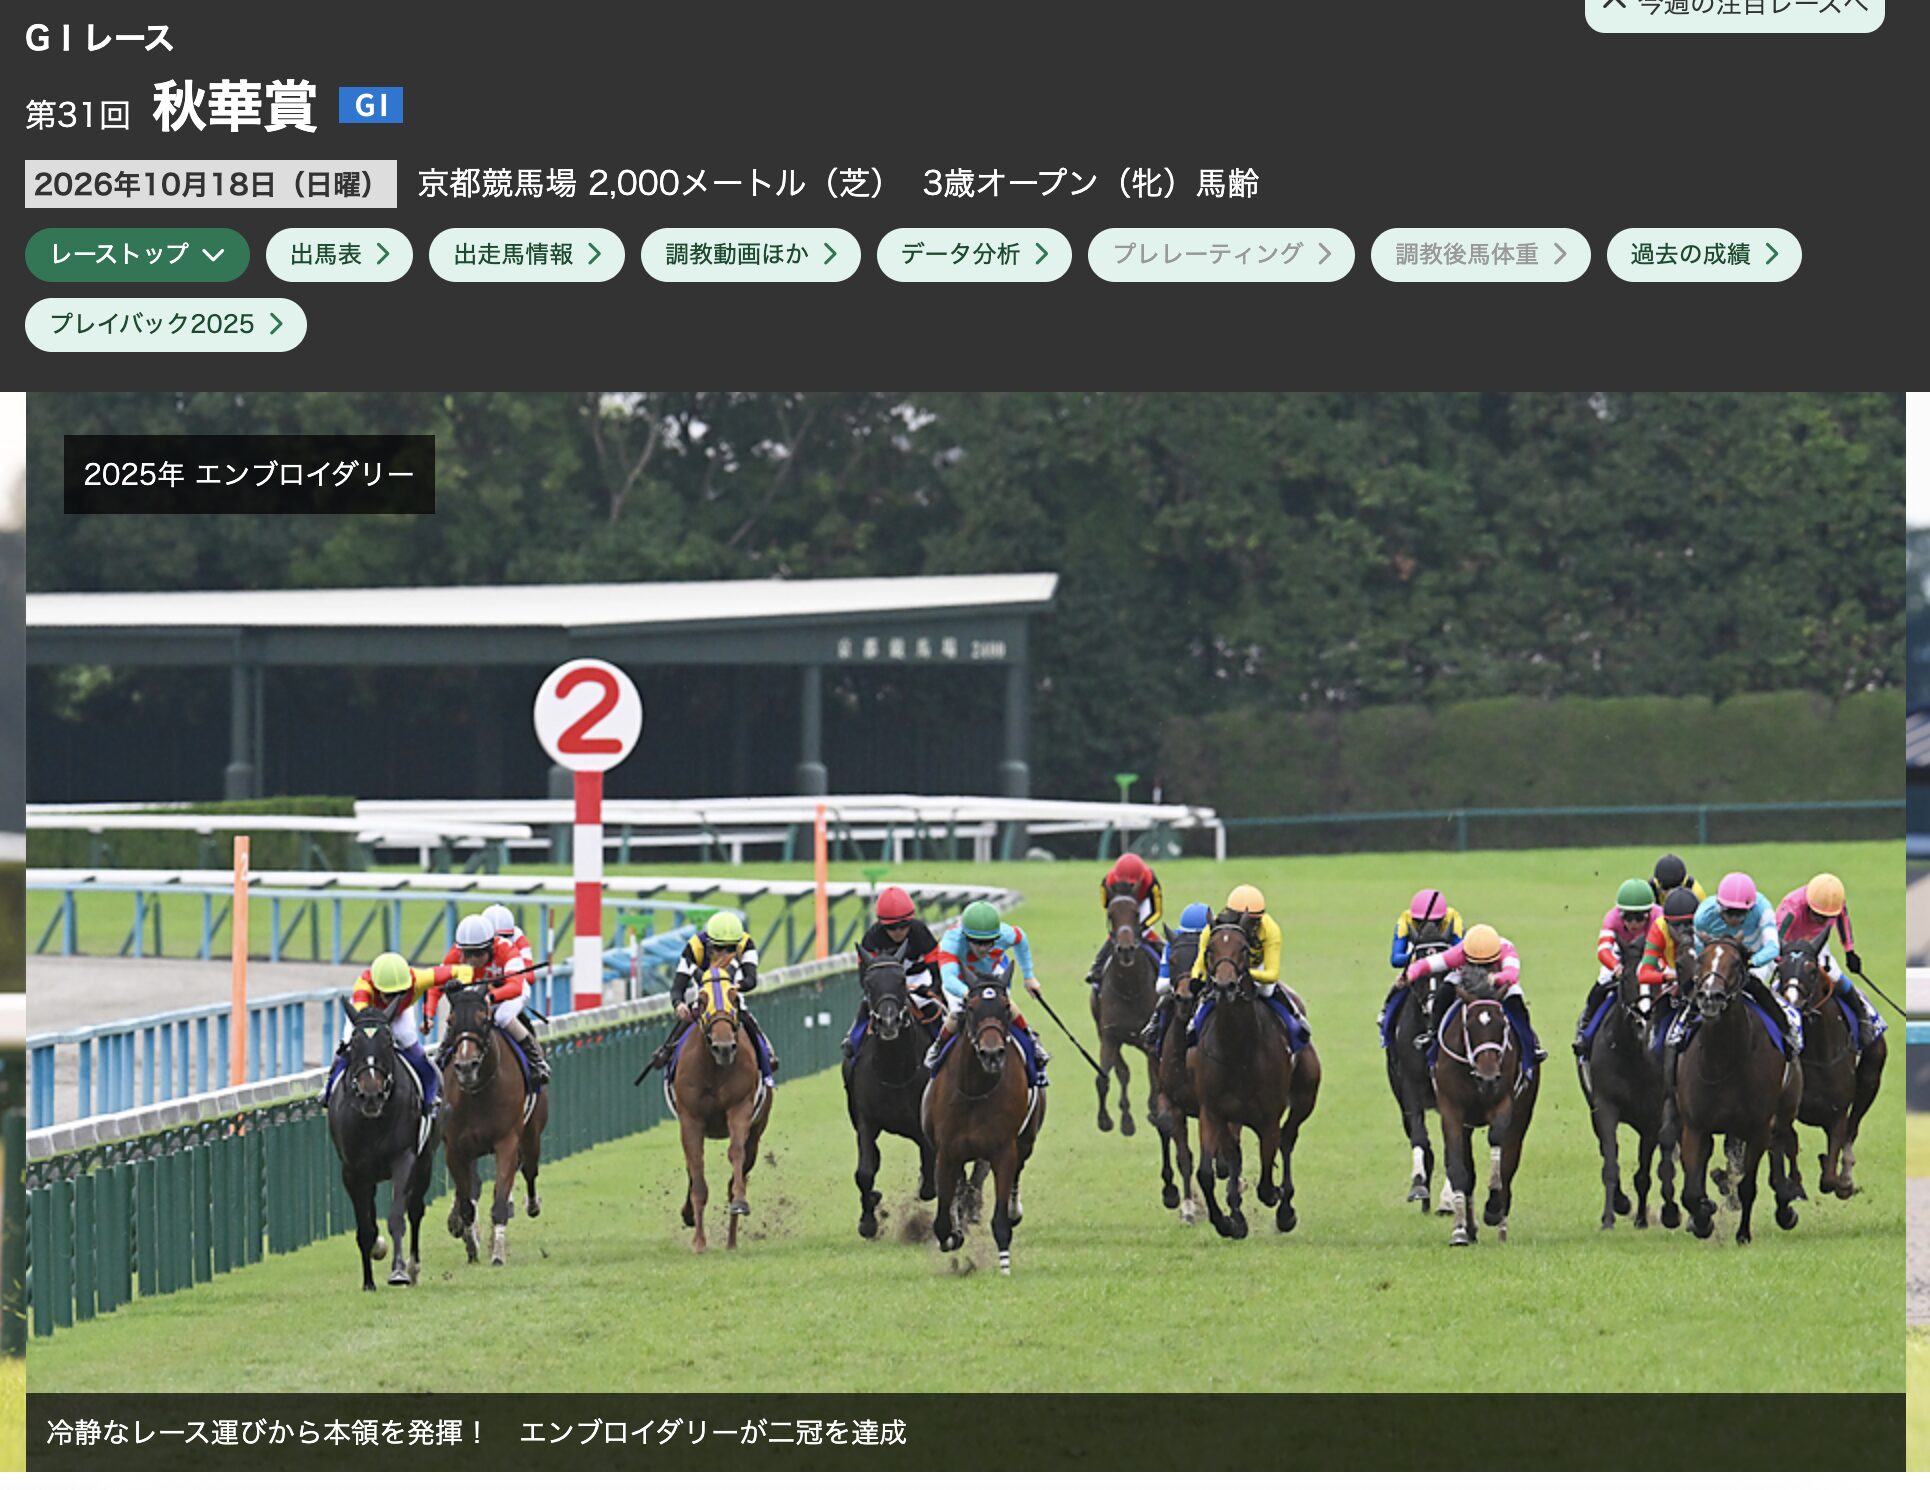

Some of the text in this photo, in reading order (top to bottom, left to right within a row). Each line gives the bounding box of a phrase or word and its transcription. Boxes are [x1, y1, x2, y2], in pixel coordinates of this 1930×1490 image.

[25, 78, 318, 134] 第31回 秋華賞
[355, 92, 387, 118] GI
[34, 170, 372, 199] 2026年10月18日（日曜）
[417, 166, 1260, 201] 京都競馬場 2,000メートル（芝） 3歳オープン（牝）馬齢
[50, 241, 190, 267] レーストップ
[291, 241, 362, 266] 出馬表
[454, 241, 574, 266] 出走馬情報
[665, 241, 809, 266] 調教動画ほか
[901, 241, 1021, 266] データ分析
[1114, 241, 1305, 265] プレレーティング
[1395, 242, 1539, 266] 調教後馬体重
[1630, 241, 1751, 266] 過去の成績
[51, 311, 255, 335] プレイバック2025
[555, 667, 623, 754] 2
